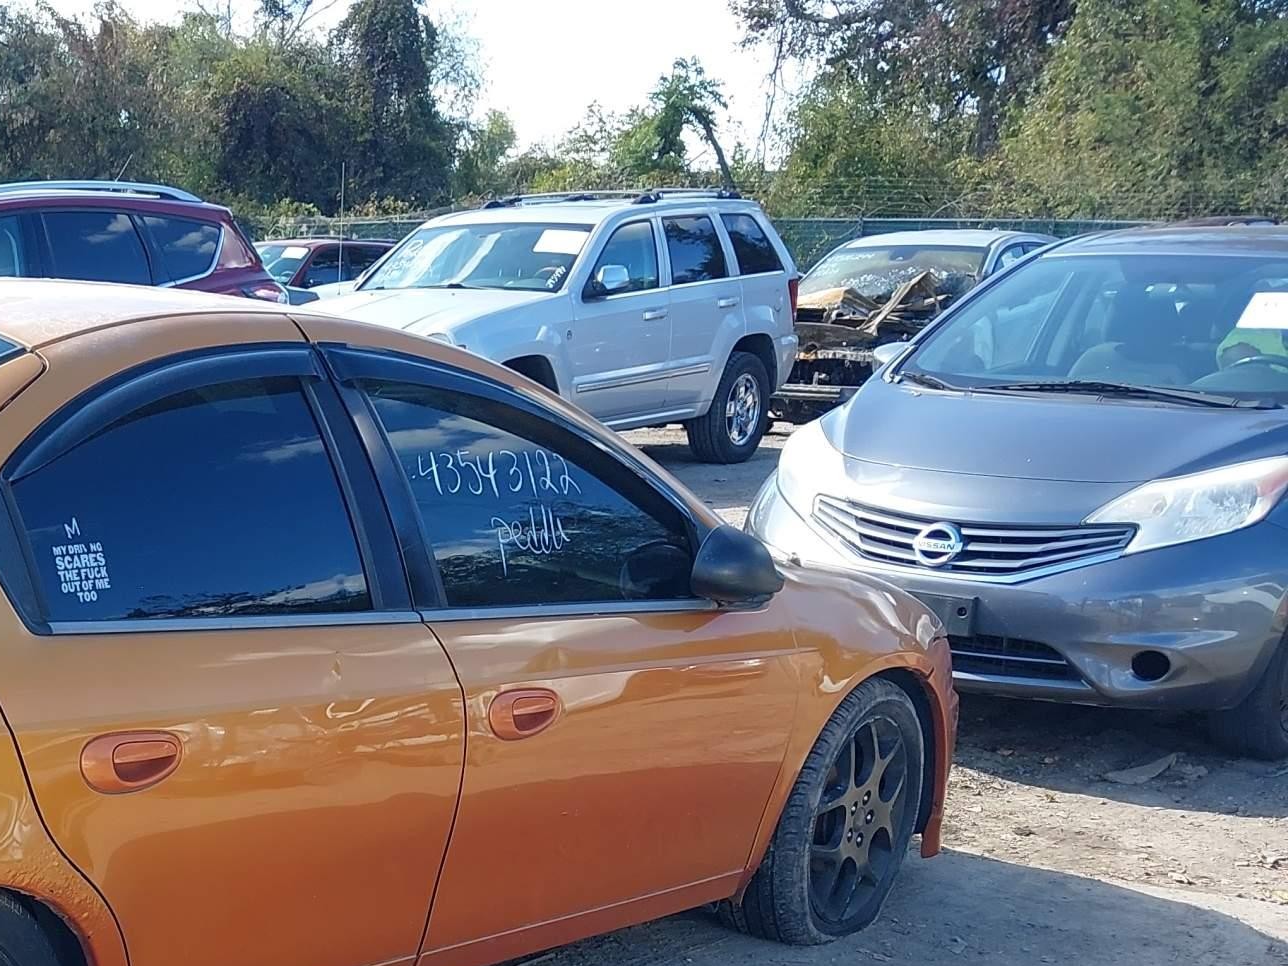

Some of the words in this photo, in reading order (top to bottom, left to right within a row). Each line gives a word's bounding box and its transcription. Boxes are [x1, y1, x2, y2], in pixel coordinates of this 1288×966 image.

[418, 449, 582, 498] 43543122
[52, 545, 67, 556] MY
[68, 542, 103, 555] DRING
[55, 552, 106, 570] SCARES
[57, 569, 80, 582] THE
[80, 566, 108, 580] FUCK
[61, 581, 81, 594] OUT
[81, 580, 94, 591] OF
[95, 578, 111, 590] ME
[77, 590, 98, 603] TOO
